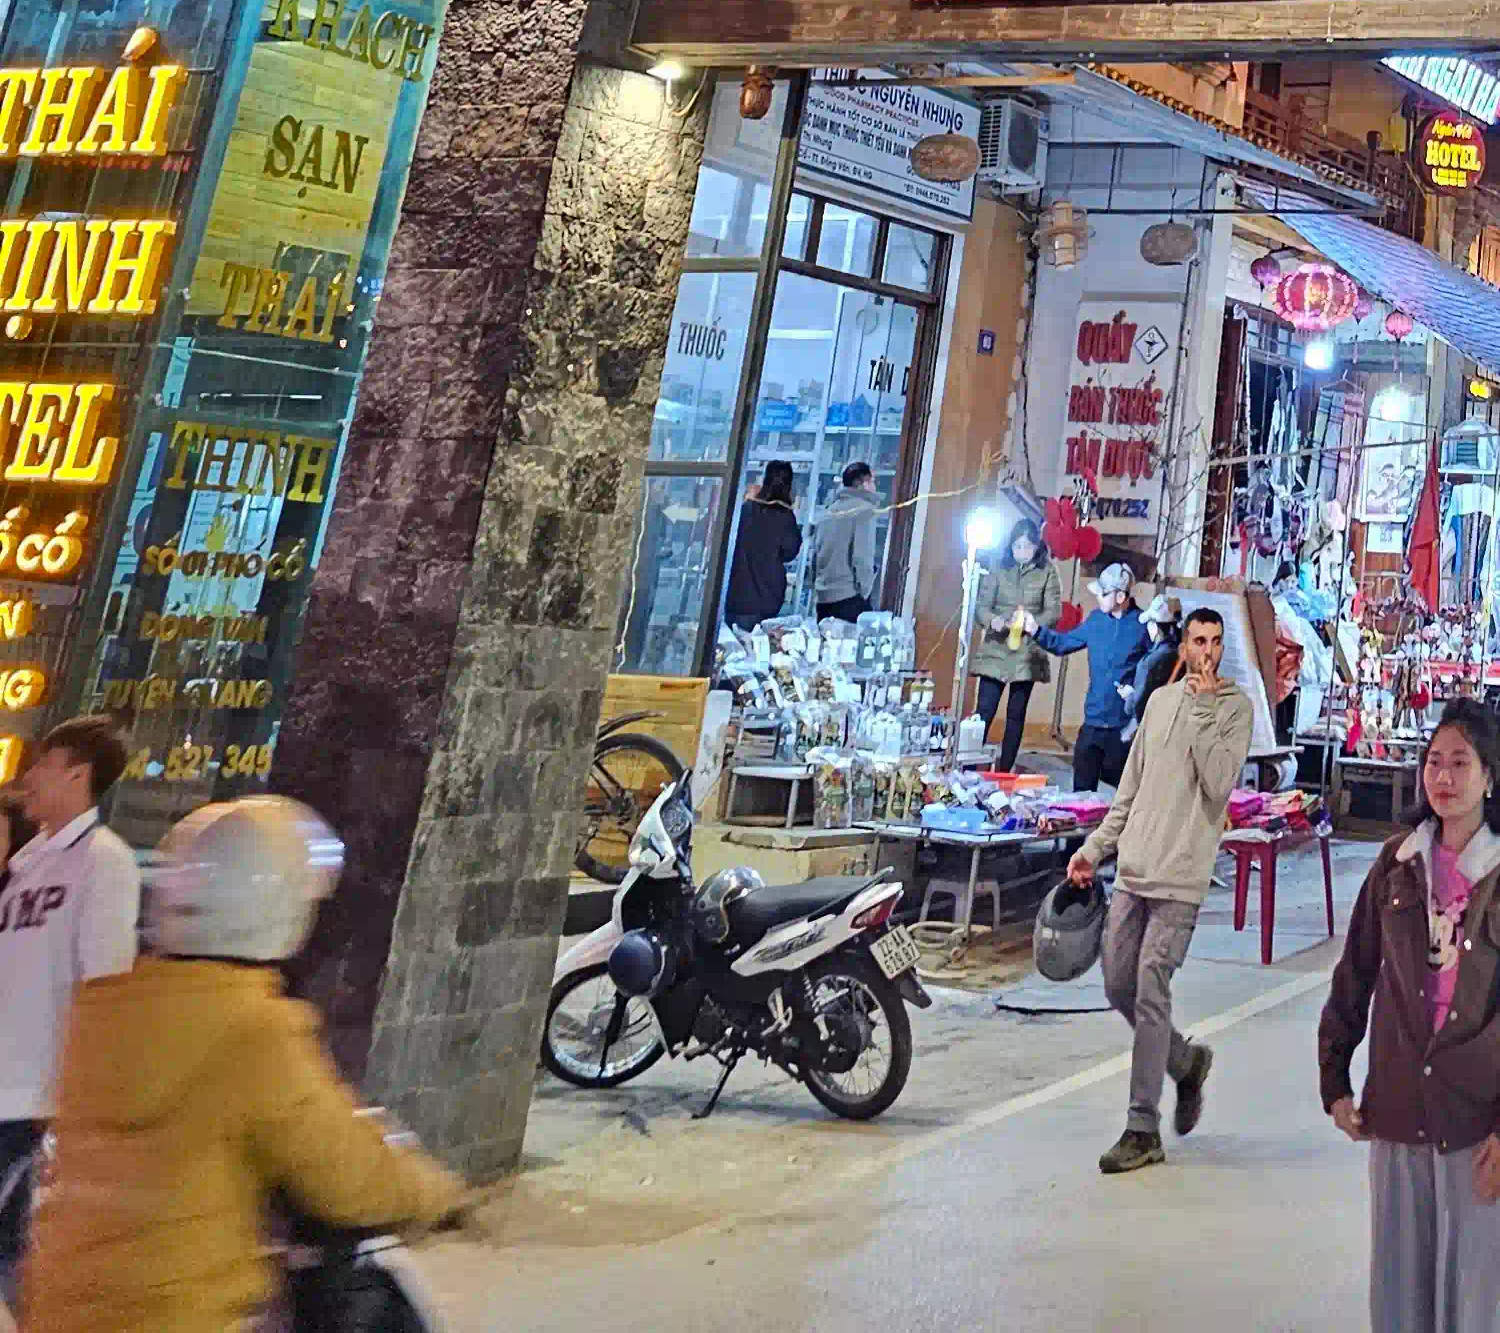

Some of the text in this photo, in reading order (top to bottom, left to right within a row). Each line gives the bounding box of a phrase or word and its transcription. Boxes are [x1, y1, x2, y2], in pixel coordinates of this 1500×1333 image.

[922, 102, 963, 132] NHUNG
[263, 114, 369, 199] SẠN
[1426, 140, 1481, 171] HOTEL
[677, 317, 726, 361] THUỐC
[868, 355, 895, 394] TÂN
